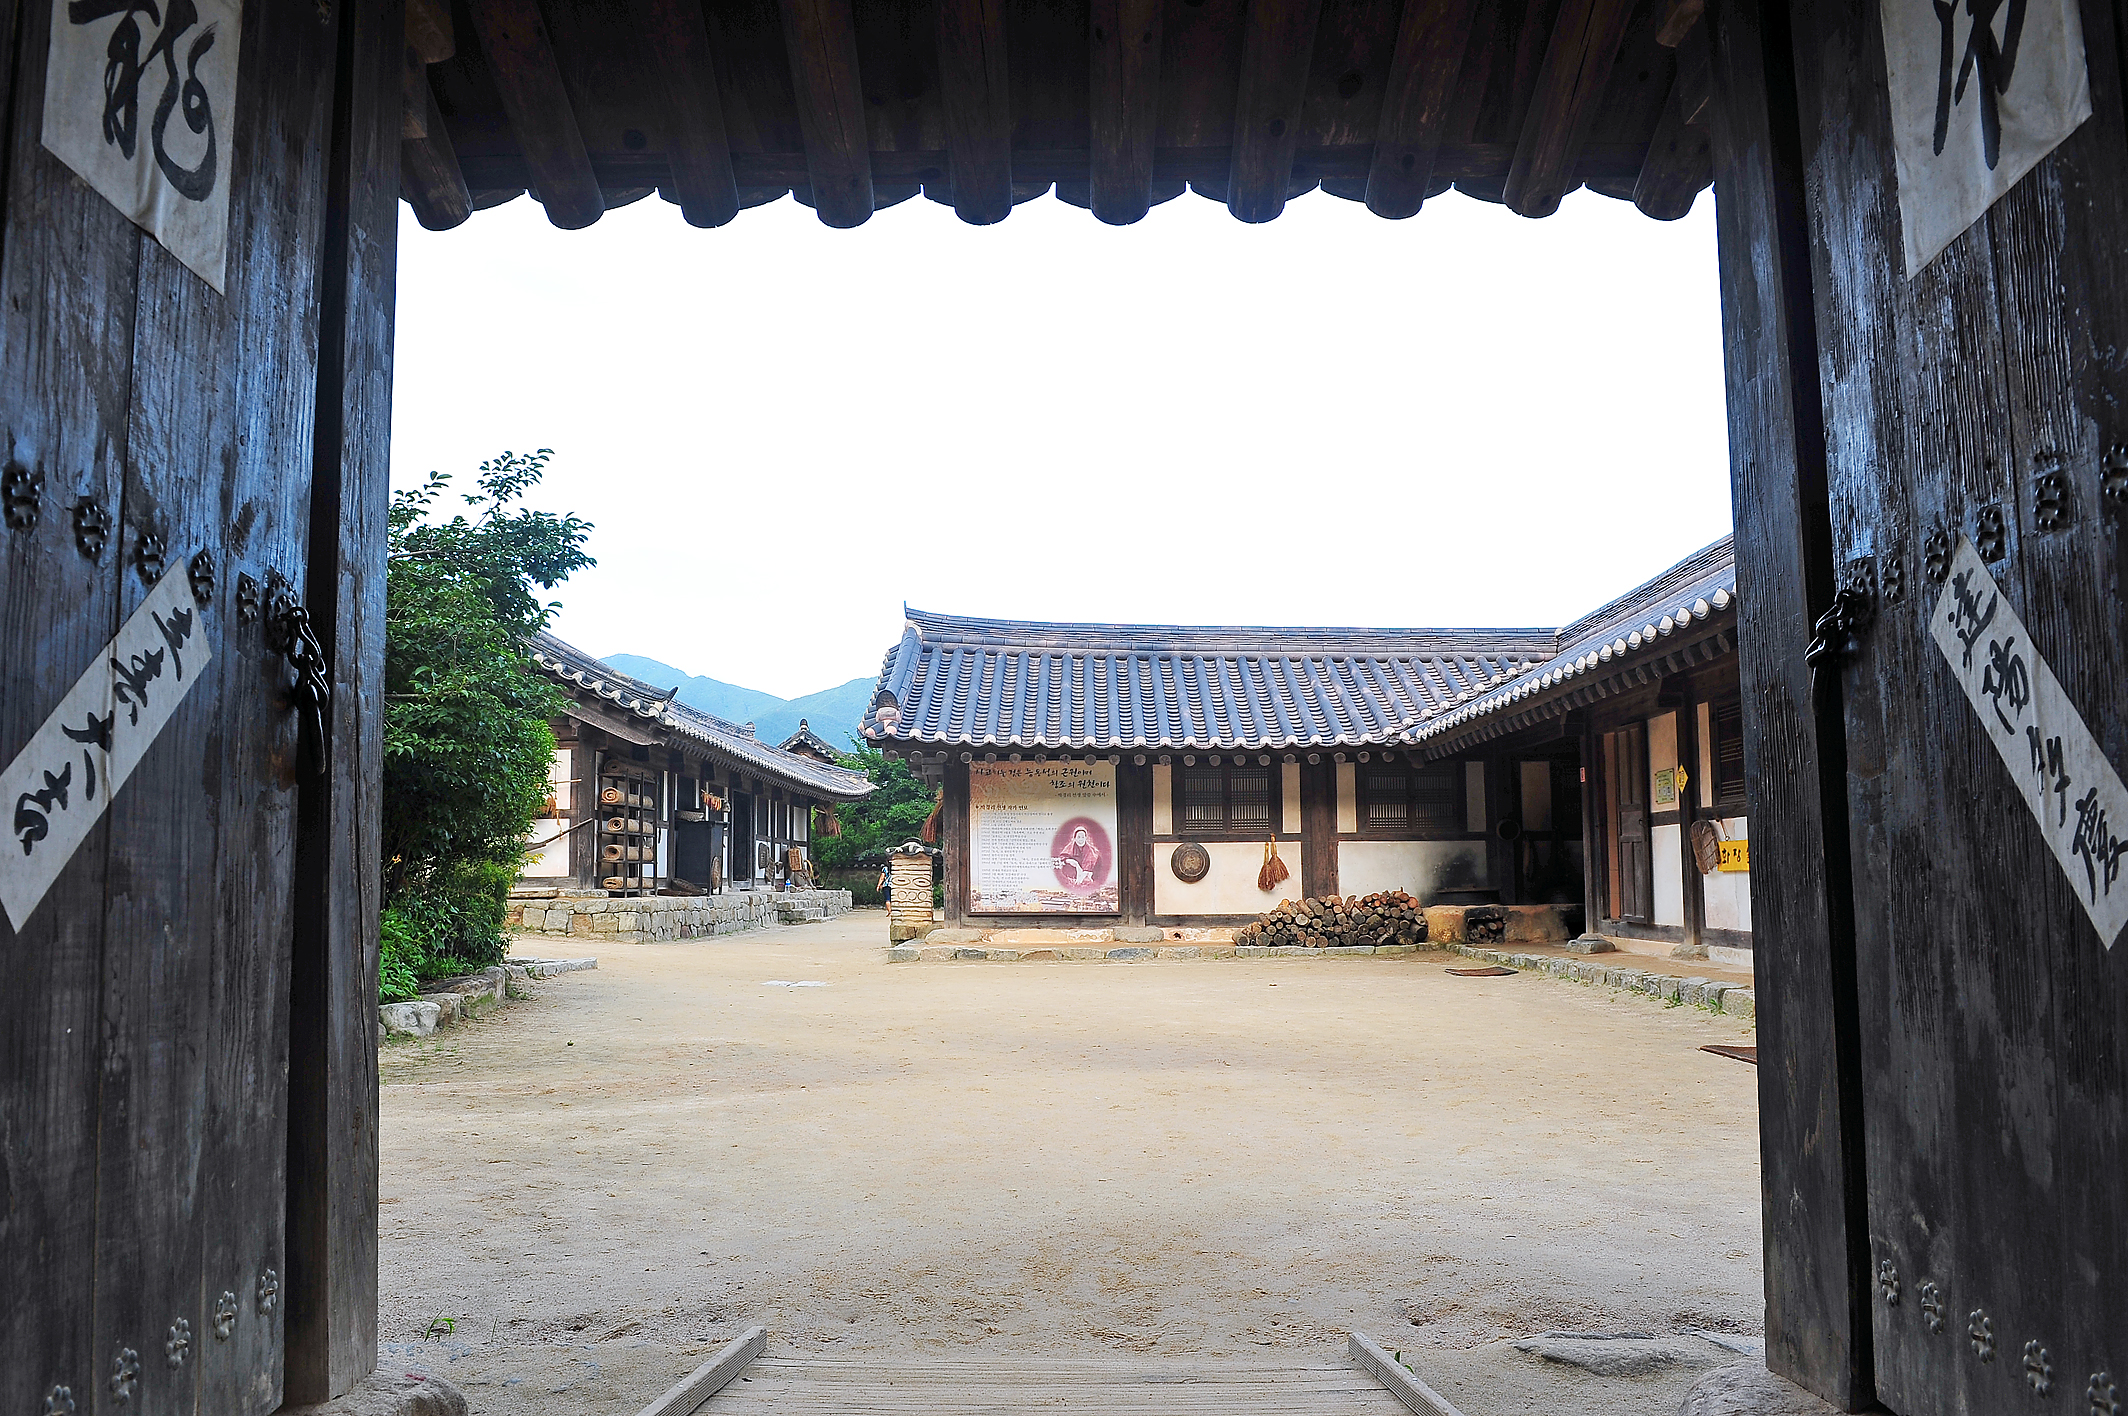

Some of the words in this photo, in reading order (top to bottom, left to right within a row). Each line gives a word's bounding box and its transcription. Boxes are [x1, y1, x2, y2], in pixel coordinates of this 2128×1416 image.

[14, 606, 193, 856] 立春大吉
[1009, 768, 1022, 778] 것은
[1049, 779, 1075, 789] 창조의
[1077, 779, 1110, 789] 원천이다
